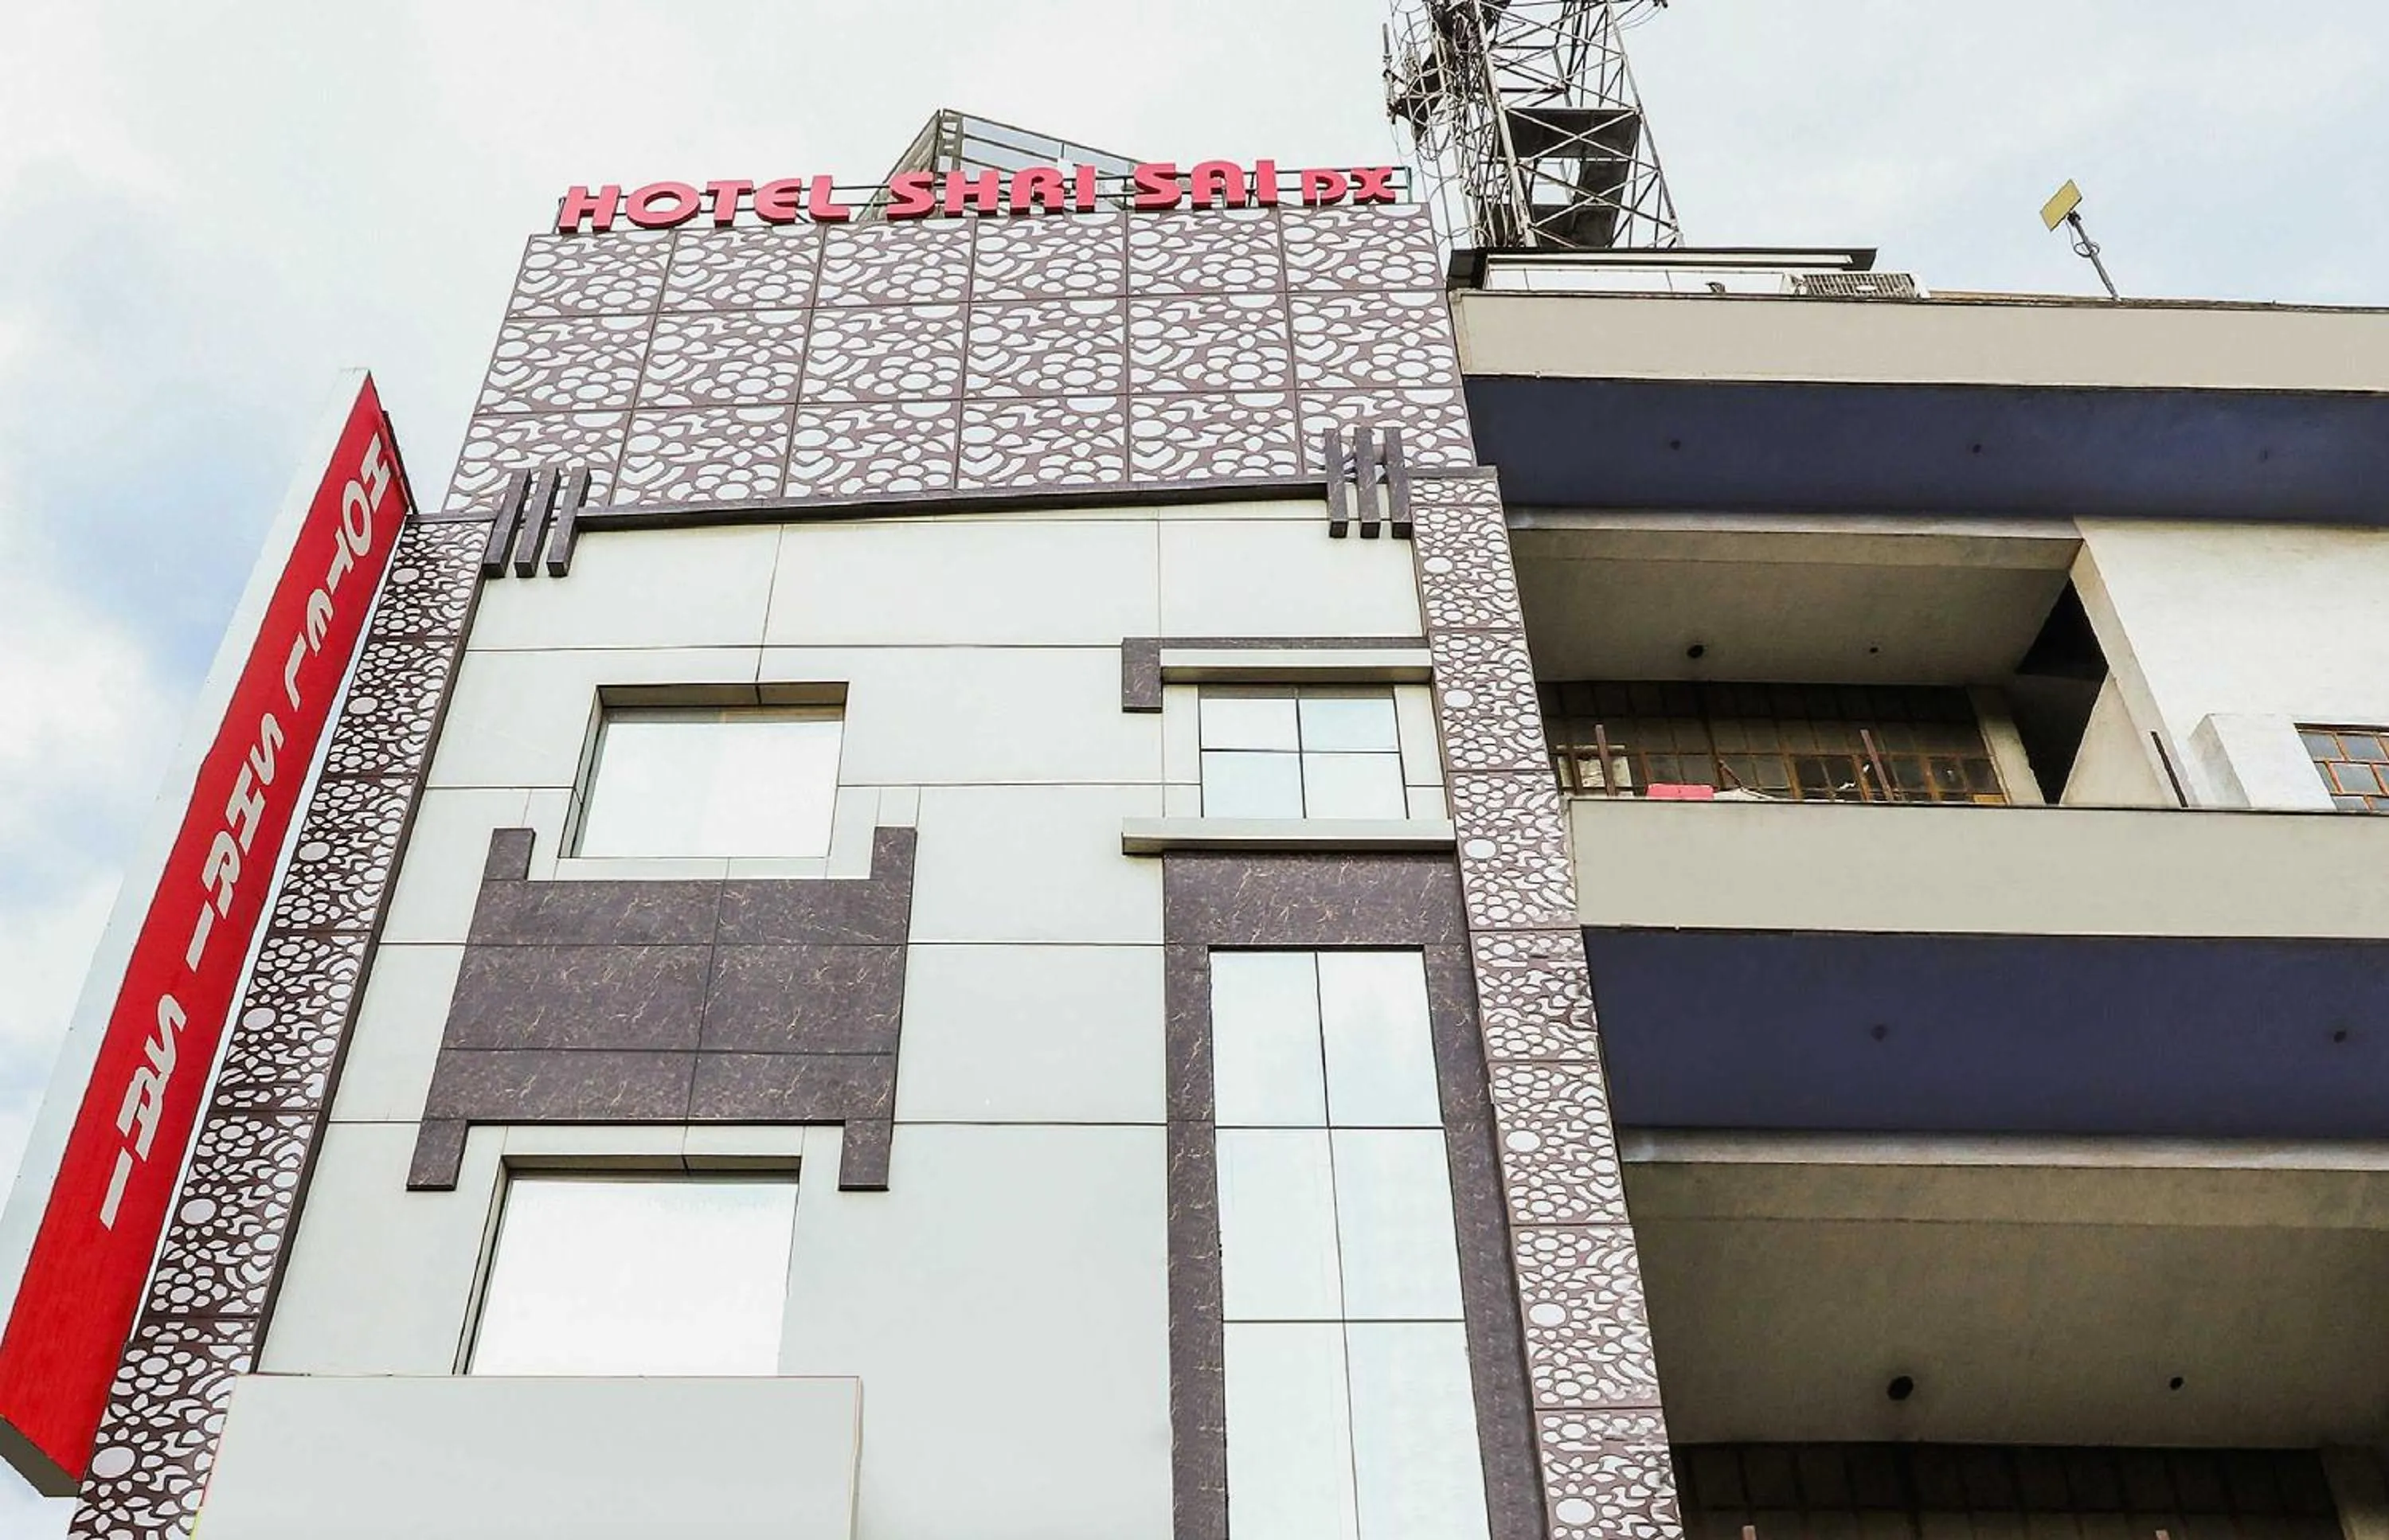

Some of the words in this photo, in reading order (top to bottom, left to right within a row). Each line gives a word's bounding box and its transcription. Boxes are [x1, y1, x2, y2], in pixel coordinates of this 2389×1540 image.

[558, 174, 850, 235] HOTEL
[886, 165, 1097, 220] SHRI
[1134, 159, 1277, 211] SAI
[283, 432, 391, 712] HOTEL
[186, 713, 285, 973] SHRI
[100, 993, 187, 1231] SAI
